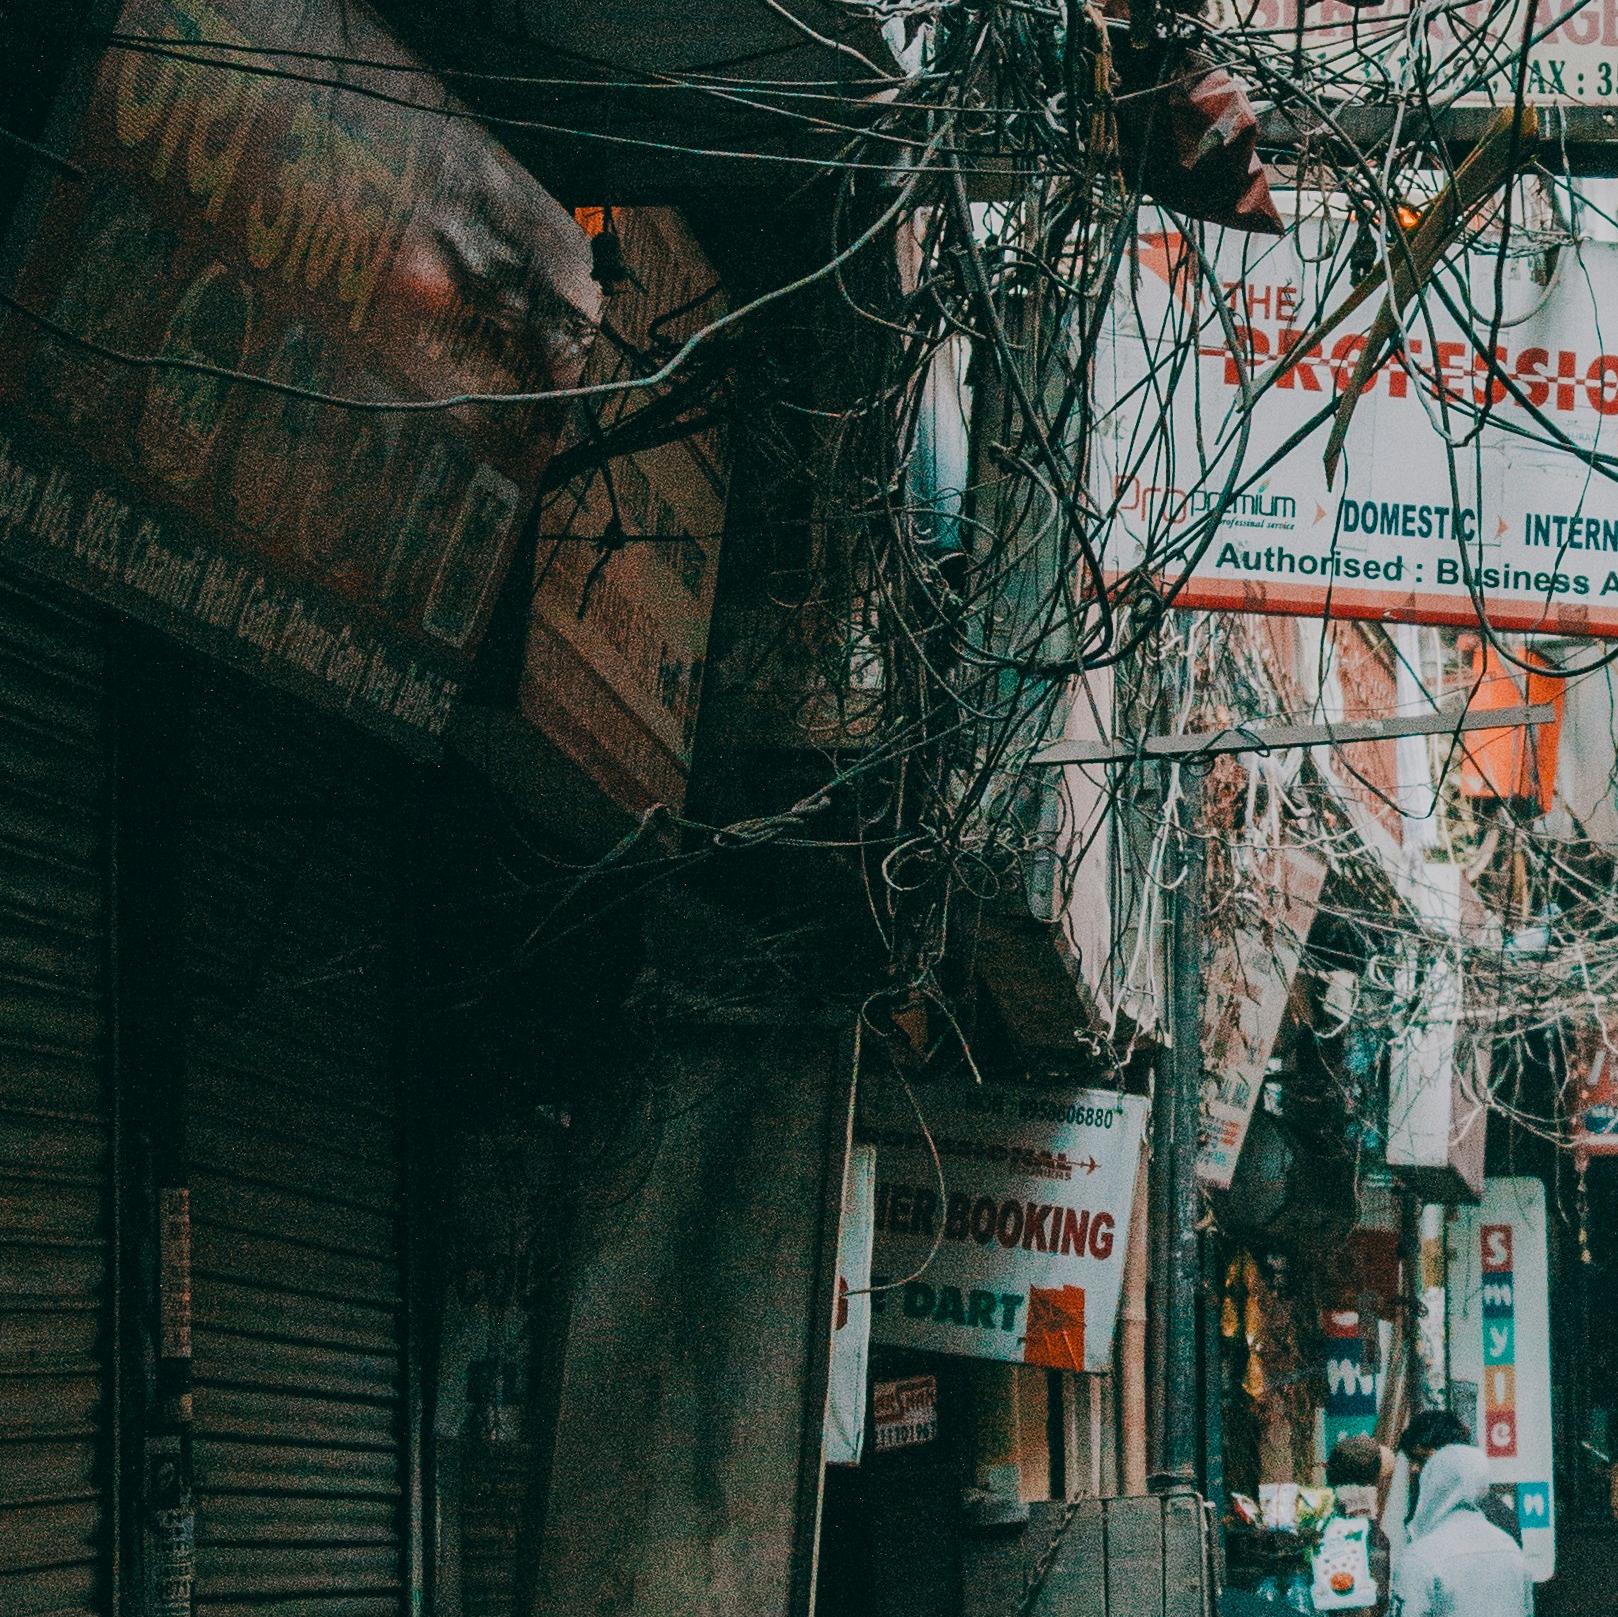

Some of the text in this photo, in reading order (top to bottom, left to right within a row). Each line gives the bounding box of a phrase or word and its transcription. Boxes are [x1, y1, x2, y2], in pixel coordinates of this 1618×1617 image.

[1222, 281, 1298, 322] THE
[1343, 497, 1477, 543] DOMESTIC
[1216, 541, 1404, 582] Authorised
[1437, 556, 1591, 596] Business
[944, 1191, 1117, 1261] BOOKING
[903, 1280, 1025, 1332] DART
